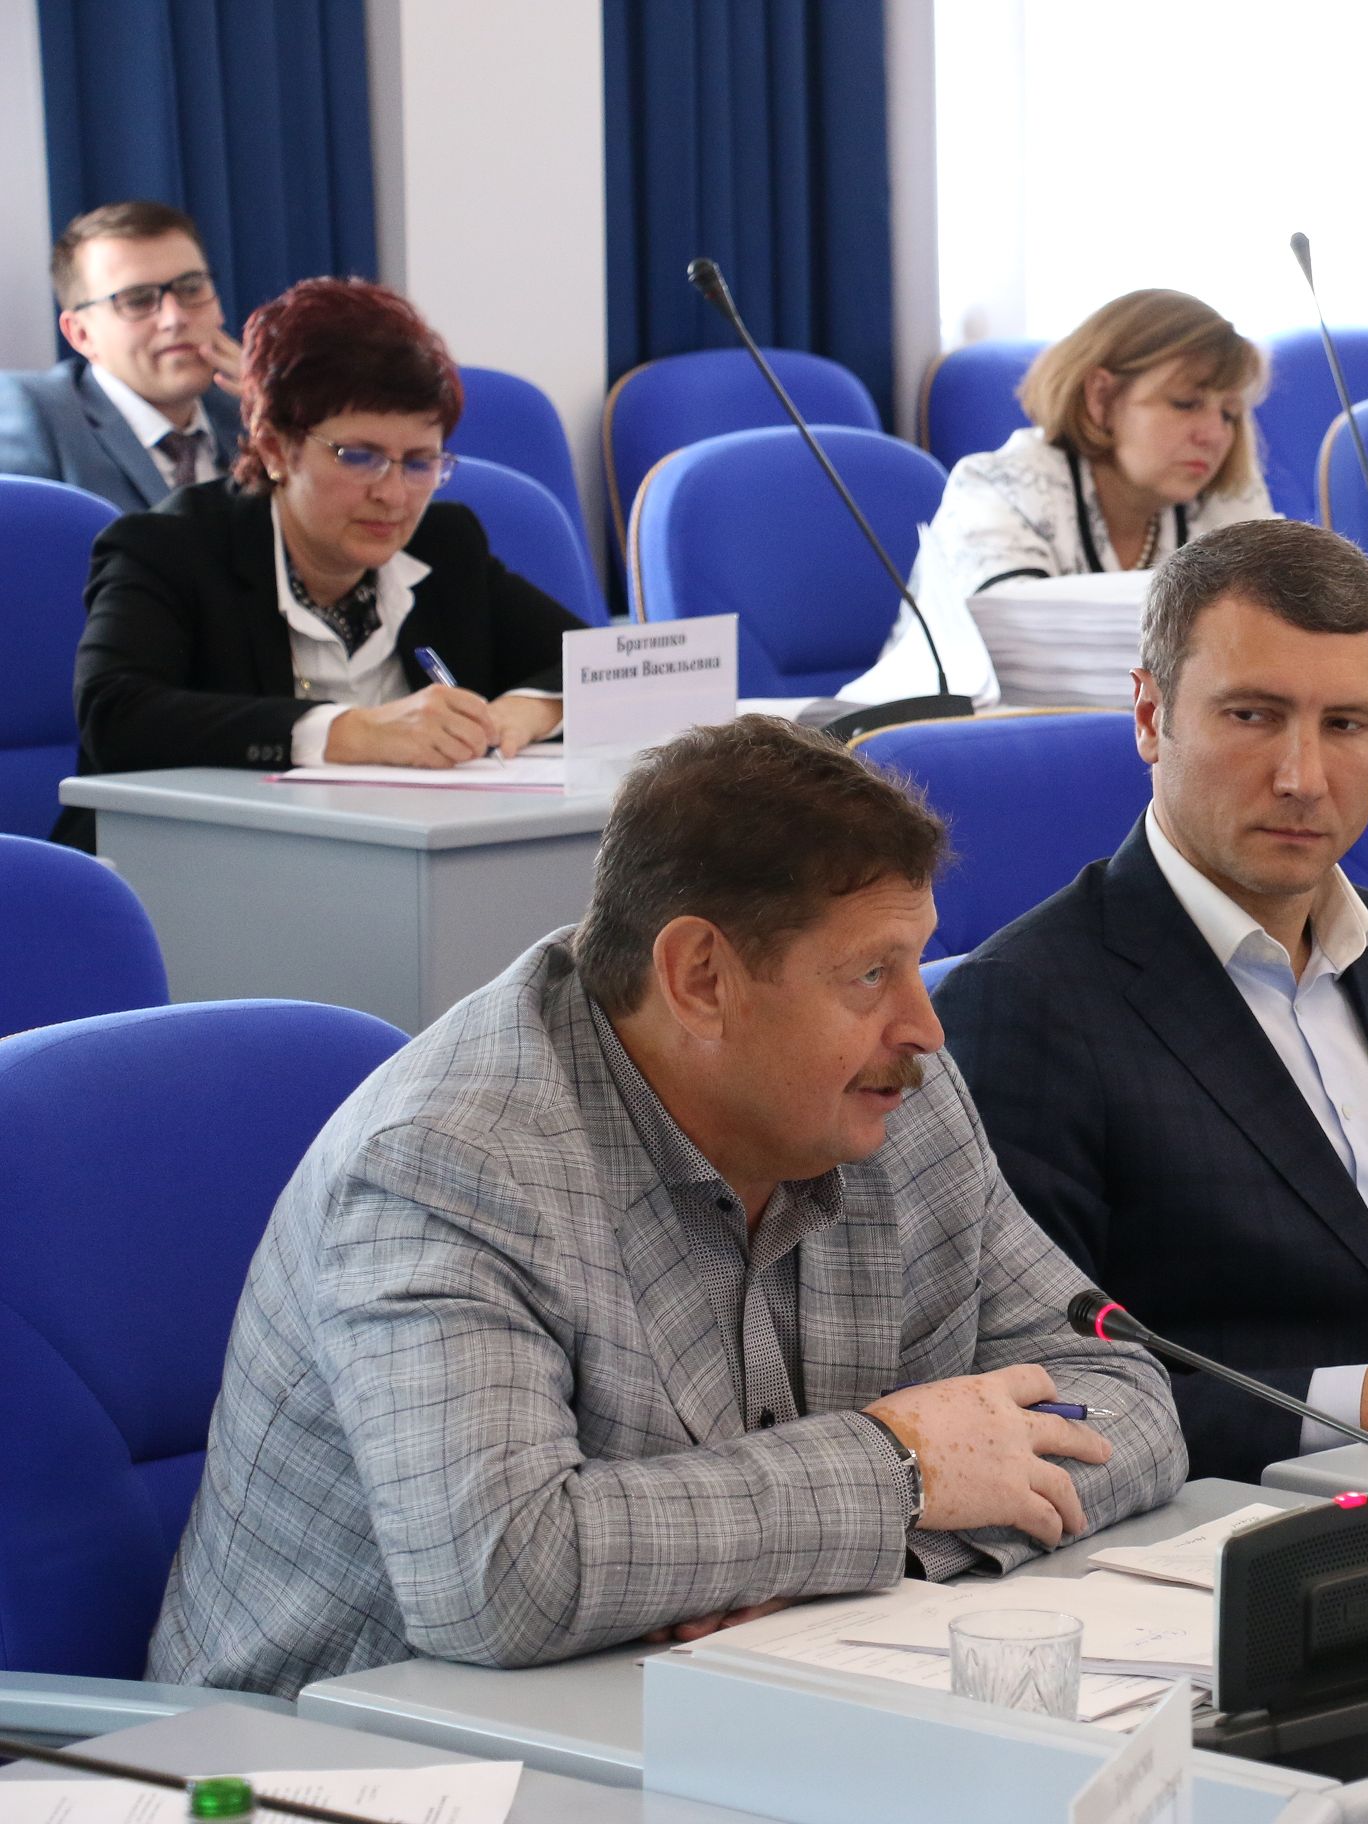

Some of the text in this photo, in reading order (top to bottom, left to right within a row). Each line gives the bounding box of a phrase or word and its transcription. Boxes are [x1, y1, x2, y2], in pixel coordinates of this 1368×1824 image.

[616, 633, 686, 656] Братишко
[581, 655, 721, 685] Евгения Васильевна
